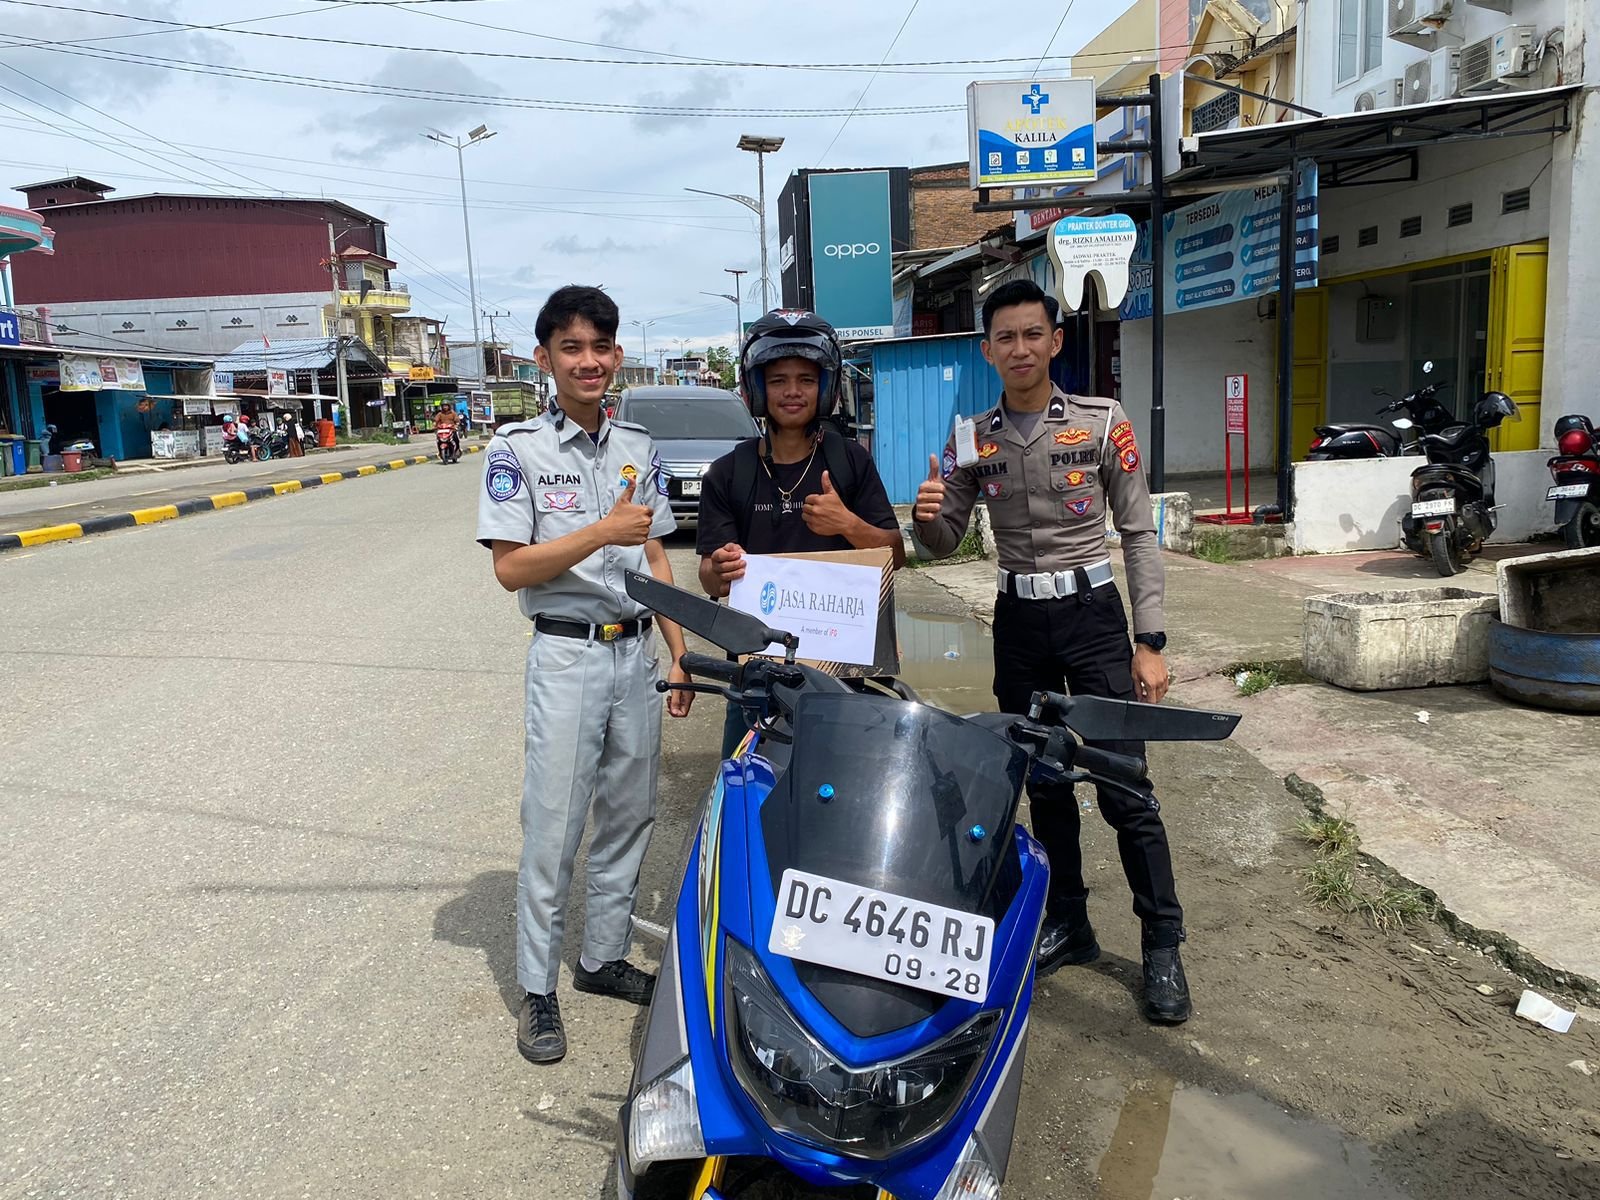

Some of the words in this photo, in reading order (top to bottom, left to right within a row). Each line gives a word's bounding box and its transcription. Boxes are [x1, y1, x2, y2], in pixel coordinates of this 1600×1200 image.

[1015, 132, 1057, 143] KALILA
[1186, 203, 1220, 225] TERSEDIA
[1067, 221, 1094, 232] PRAKTEK
[824, 242, 880, 259] oppo
[852, 328, 884, 337] PONSEL
[1051, 449, 1096, 466] POLRI
[538, 474, 581, 485] ALFIAN
[684, 482, 693, 490] DP
[778, 589, 805, 611] JASA
[808, 592, 865, 619] RAHARJA
[805, 627, 823, 636] member
[785, 879, 832, 924] DC
[842, 895, 931, 949] 4646
[940, 915, 987, 962] RJ
